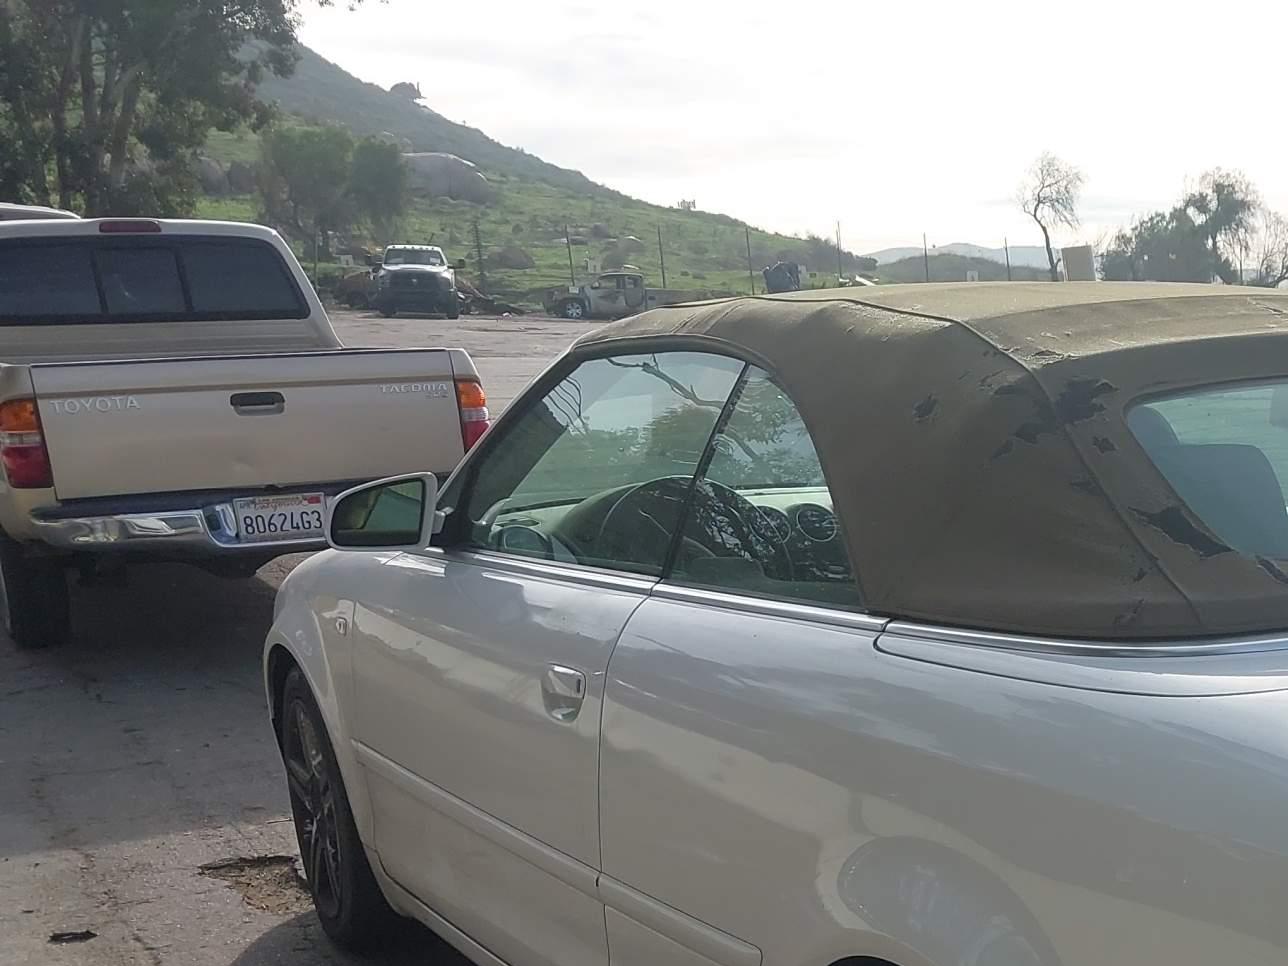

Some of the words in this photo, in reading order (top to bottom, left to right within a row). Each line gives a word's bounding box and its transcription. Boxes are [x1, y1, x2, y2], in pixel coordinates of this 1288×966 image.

[378, 383, 448, 394] TACOMA
[48, 393, 141, 414] TOYOTA
[242, 510, 323, 535] 80624G3
